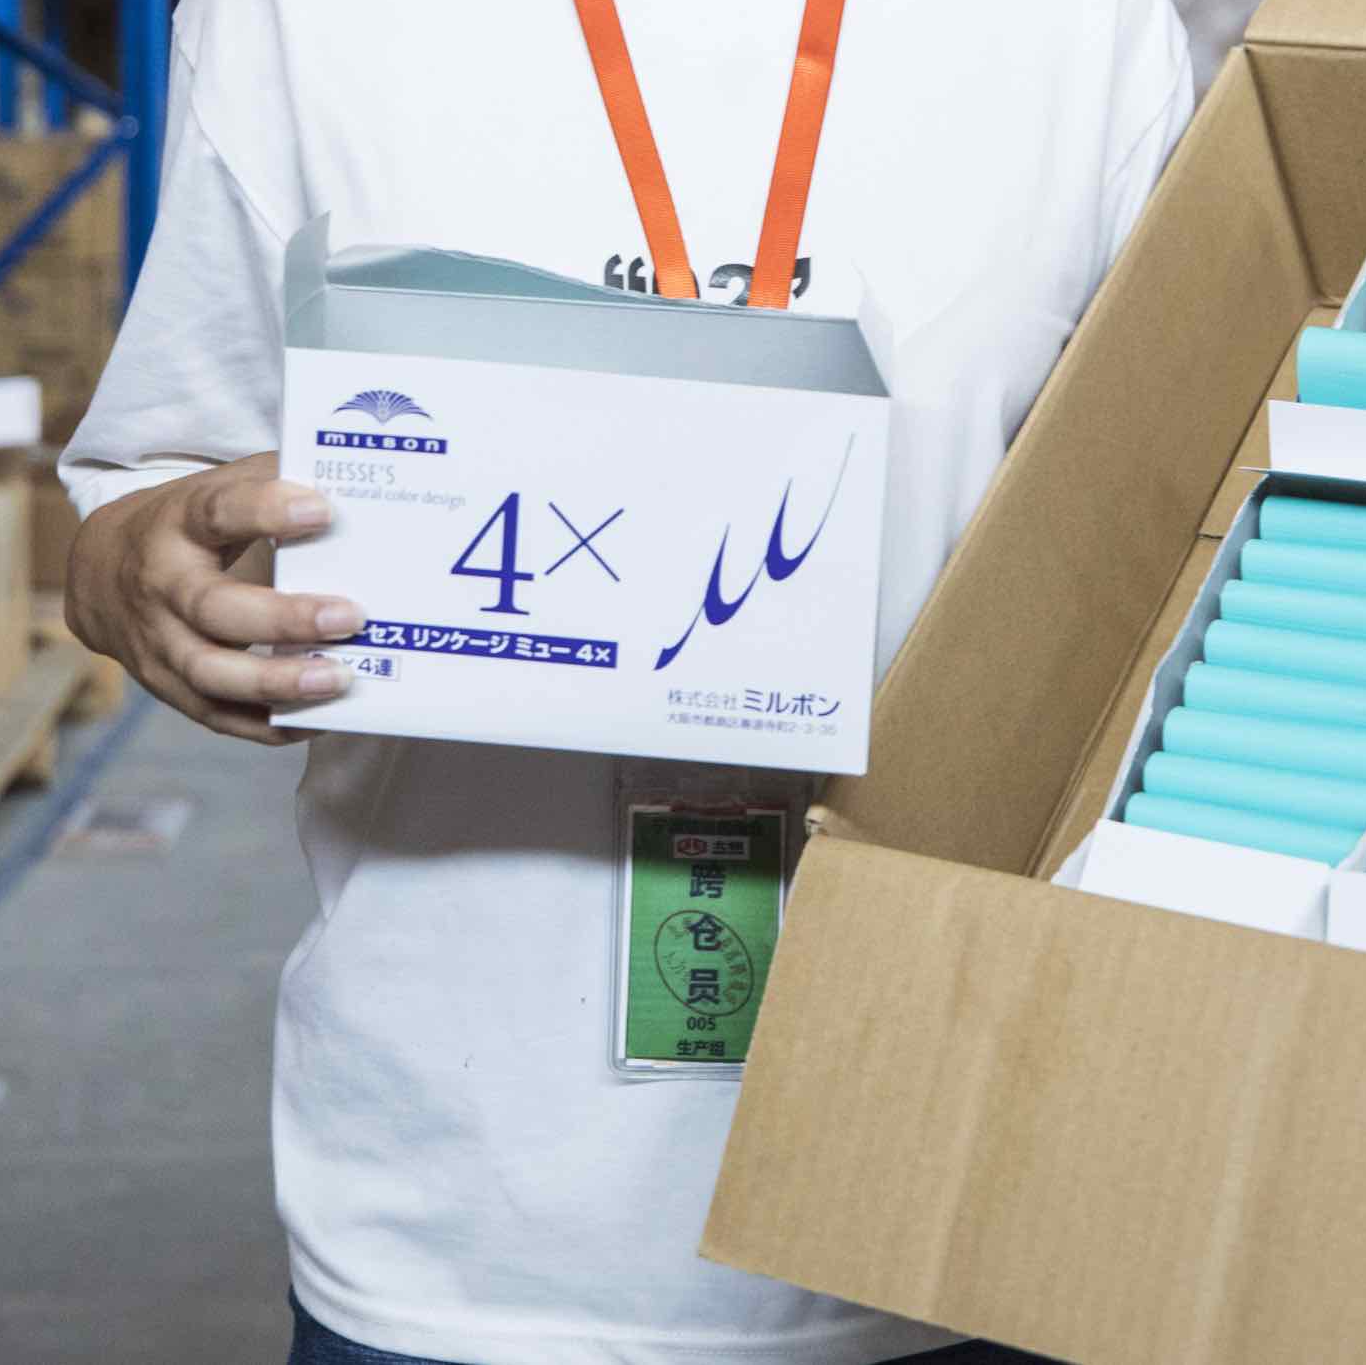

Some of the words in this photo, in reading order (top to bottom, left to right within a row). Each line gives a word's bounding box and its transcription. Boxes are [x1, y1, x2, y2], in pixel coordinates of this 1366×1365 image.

[315, 459, 396, 485] DEESSE'S
[668, 689, 738, 710] 株式会社
[743, 689, 841, 717] ミルボン
[686, 1017, 716, 1031] 005
